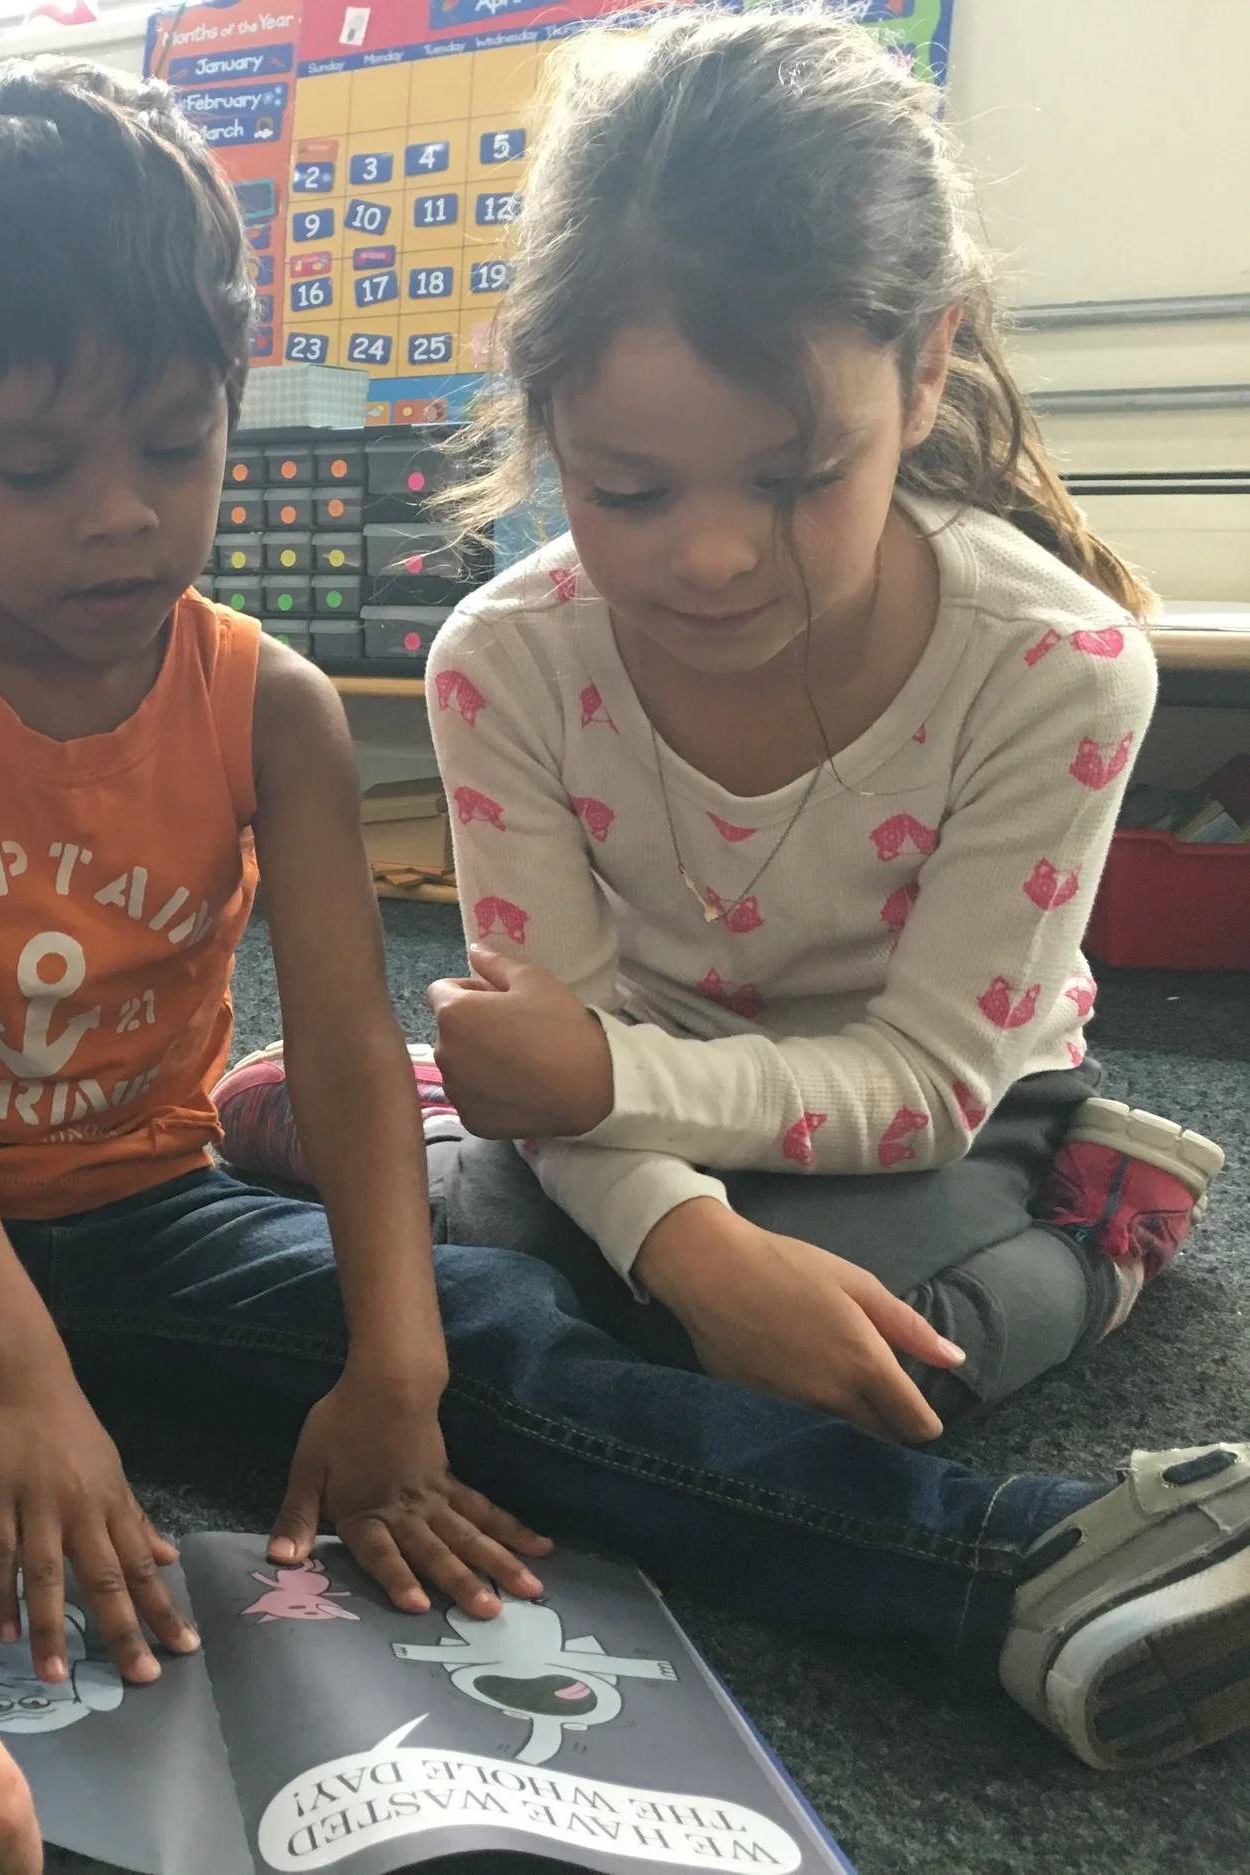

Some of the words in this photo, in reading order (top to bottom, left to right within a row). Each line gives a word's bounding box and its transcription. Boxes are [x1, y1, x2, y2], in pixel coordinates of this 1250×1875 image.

[220, 23, 235, 37] of
[238, 20, 258, 33] the
[259, 12, 294, 30] Year
[195, 55, 264, 75] January
[308, 60, 345, 74] Sunday
[364, 50, 404, 64] Monday
[423, 41, 467, 56] Tuesday
[475, 29, 538, 48] Wednesday
[187, 93, 262, 111] February
[305, 167, 320, 188] 2
[362, 157, 378, 180] 3
[419, 145, 435, 169] 4
[493, 134, 510, 159] 5
[304, 214, 320, 237] 9
[351, 204, 381, 230] 10
[423, 198, 446, 222] 11
[484, 197, 514, 220] 12
[298, 282, 324, 307] 16
[362, 275, 389, 302] 17
[417, 272, 444, 295] 18
[479, 264, 507, 288] 19
[291, 337, 321, 360] 23
[353, 337, 384, 360] 24
[413, 336, 446, 360] 25
[116, 989, 156, 1034] 21
[292, 1761, 406, 1818] DAY!
[421, 1760, 619, 1814] WHOLE
[287, 1788, 511, 1857] WASTED
[523, 1800, 671, 1849] HAVE
[629, 1798, 748, 1832] THE
[684, 1833, 782, 1865] WE
